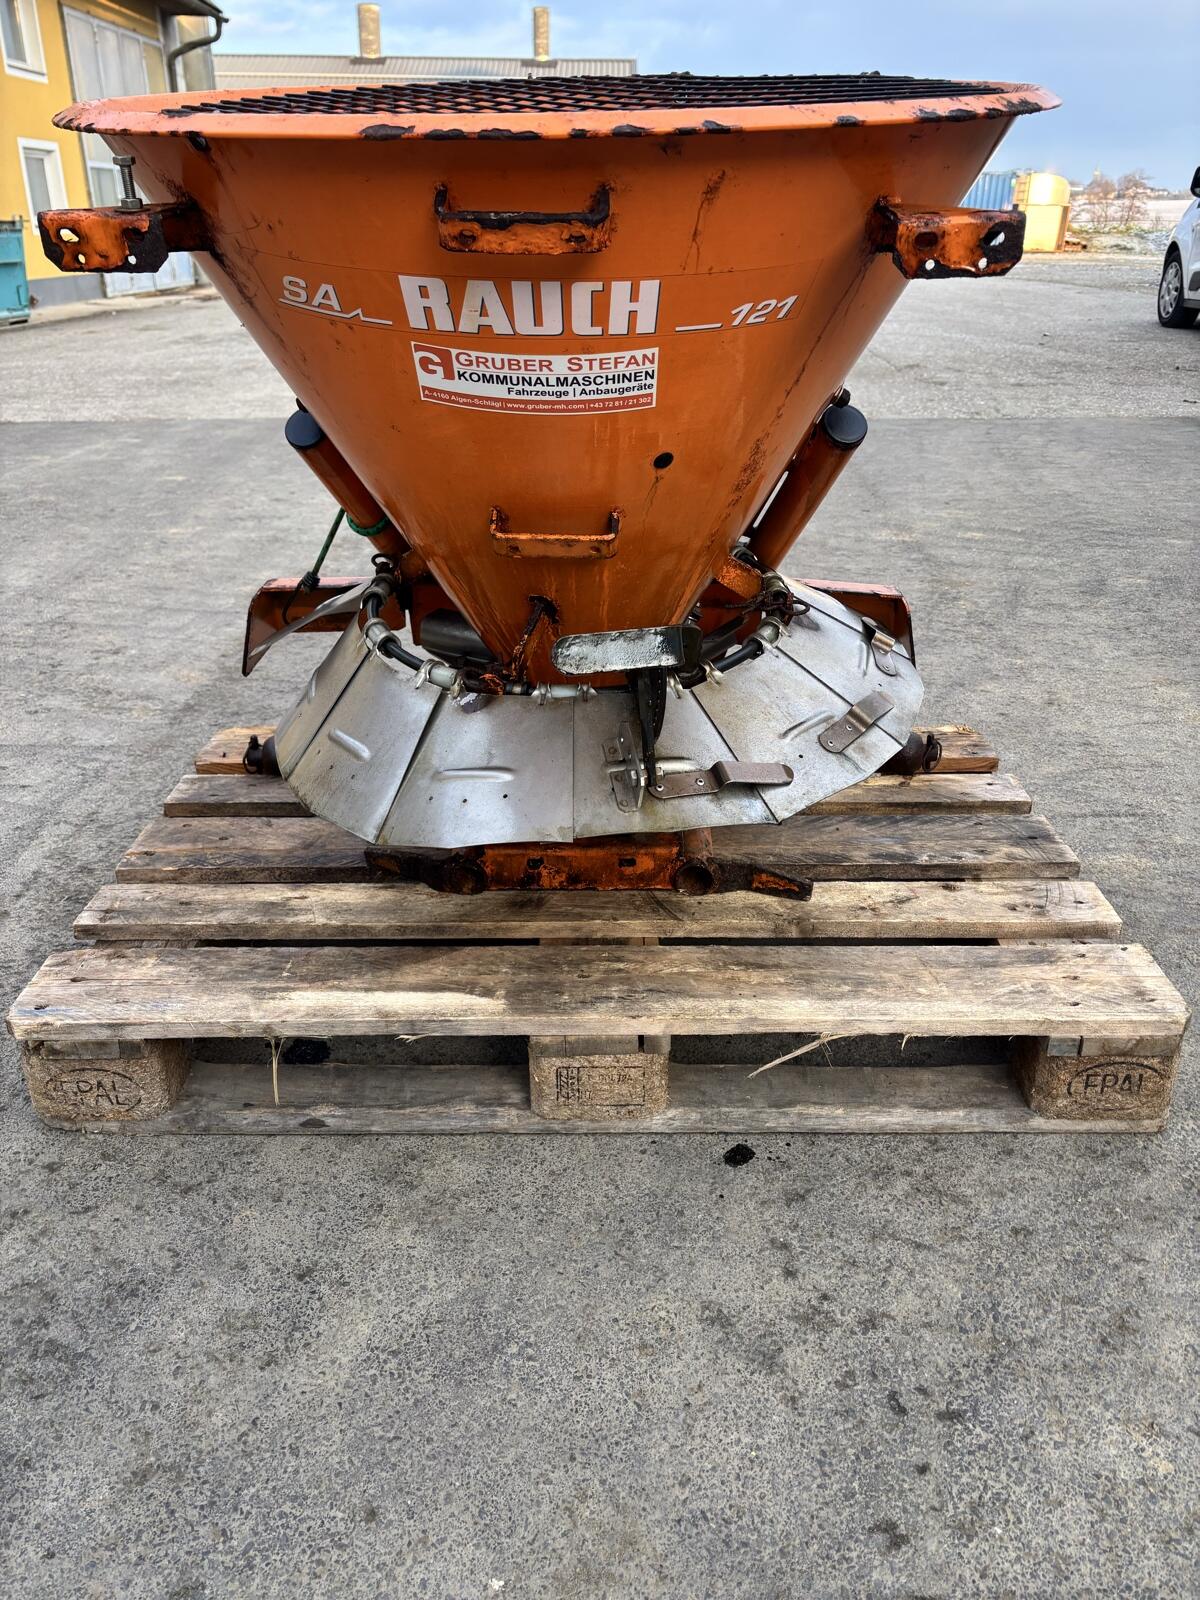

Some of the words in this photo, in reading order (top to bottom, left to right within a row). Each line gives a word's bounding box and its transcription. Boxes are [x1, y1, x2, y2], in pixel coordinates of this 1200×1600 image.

[282, 275, 343, 312] SA
[398, 275, 661, 336] RAUCH
[731, 295, 799, 327] 121
[455, 351, 554, 373] GRUBER
[567, 352, 655, 373] STEFAN
[456, 369, 655, 387] KOMMUNALMASCHINEN
[424, 390, 450, 400] A-4160
[451, 396, 502, 407] Aigen-Schlägl
[506, 402, 585, 410] www.gruber-mh.com
[507, 387, 569, 398] Fahrzeuge
[579, 383, 654, 397] Anbaugeräte
